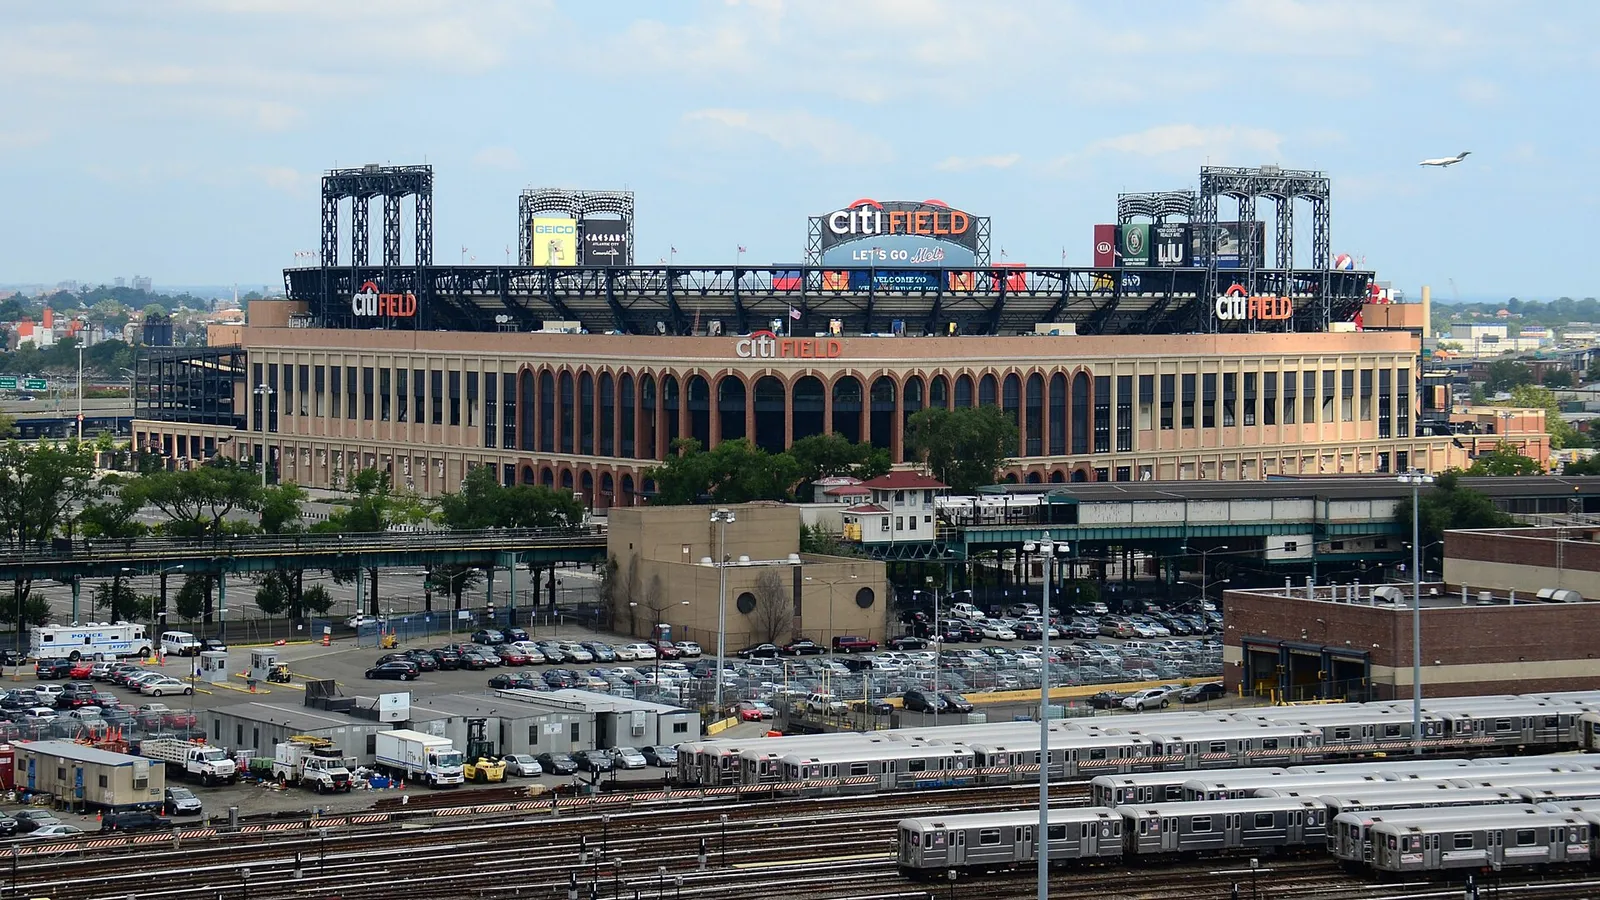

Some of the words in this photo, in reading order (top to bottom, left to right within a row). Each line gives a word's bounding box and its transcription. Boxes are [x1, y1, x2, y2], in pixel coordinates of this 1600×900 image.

[535, 225, 574, 234] GEICO
[829, 204, 881, 234] citi
[889, 211, 969, 234] FIELD
[585, 233, 626, 242] CAESARS
[852, 250, 887, 260] LET'S
[890, 250, 908, 260] GO
[910, 246, 944, 264] Mets
[1158, 239, 1183, 262] LIU
[352, 287, 378, 316] citi
[378, 294, 417, 316] FIELD
[1215, 290, 1246, 320] citi
[1247, 296, 1292, 320] FIELD
[735, 334, 776, 358] citi
[781, 339, 842, 358] FIELD
